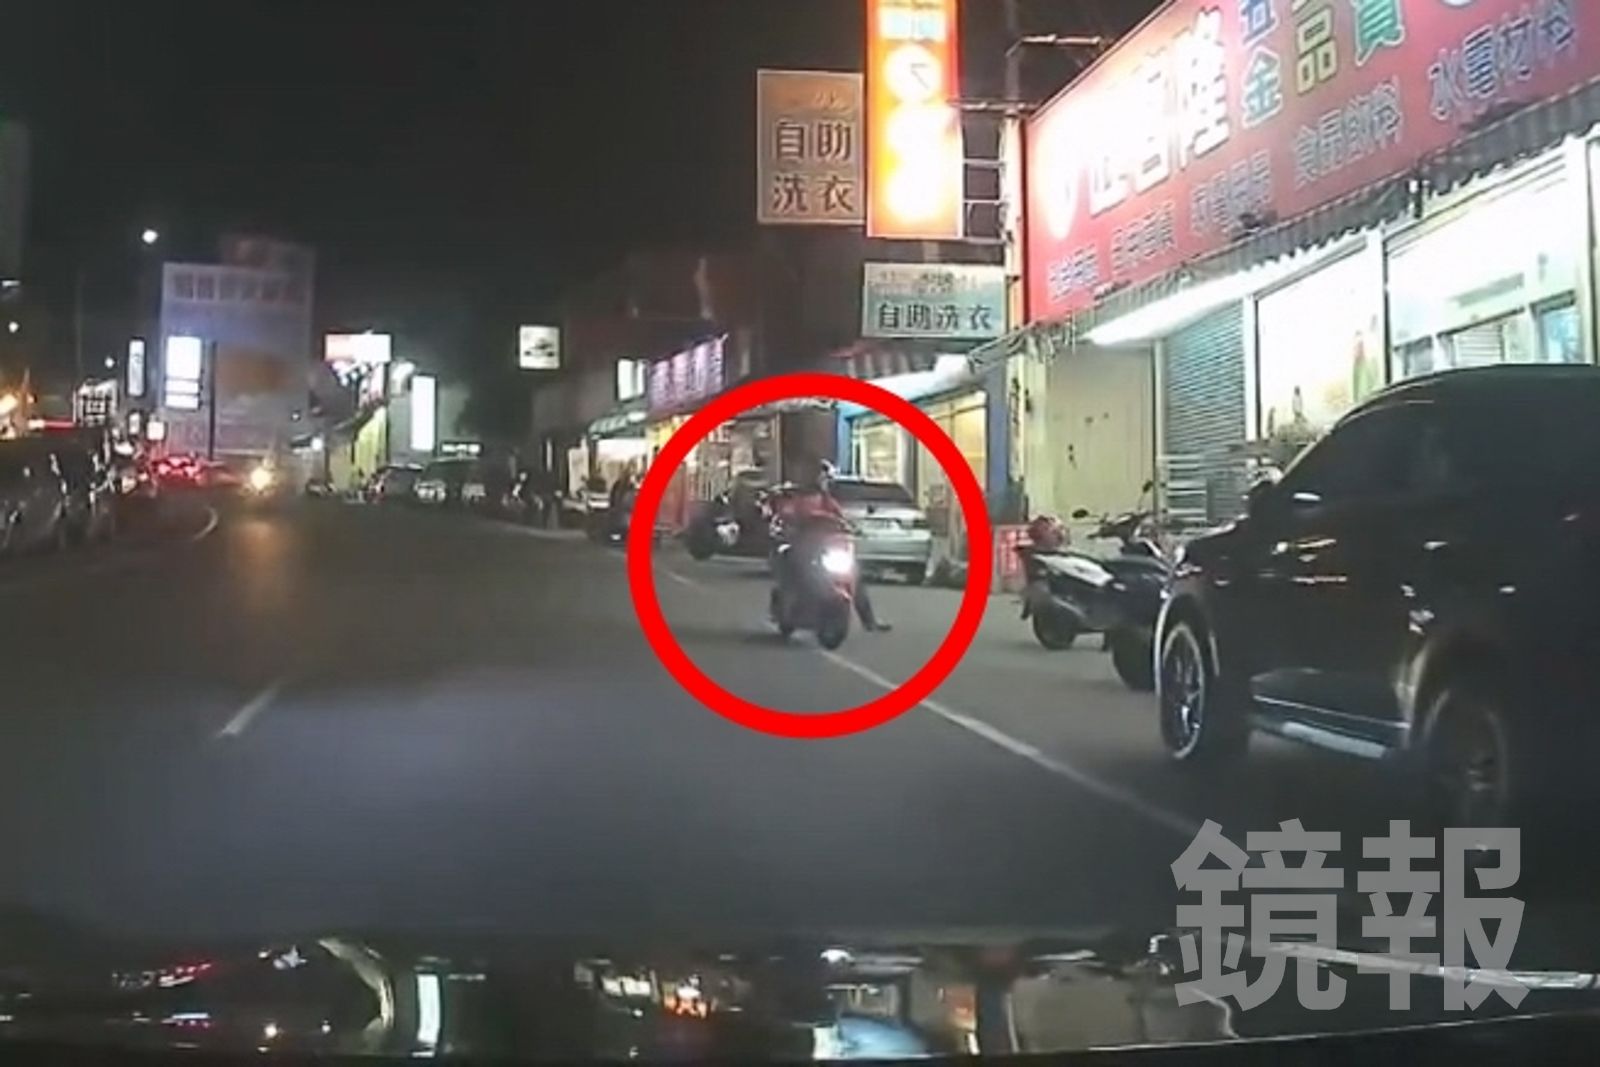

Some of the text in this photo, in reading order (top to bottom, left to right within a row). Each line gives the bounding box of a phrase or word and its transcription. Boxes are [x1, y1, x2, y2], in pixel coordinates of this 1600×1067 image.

[1292, 0, 1338, 95] 品
[776, 119, 852, 162] 自助
[772, 174, 854, 213] 洗衣
[878, 301, 992, 330] 自助洗衣
